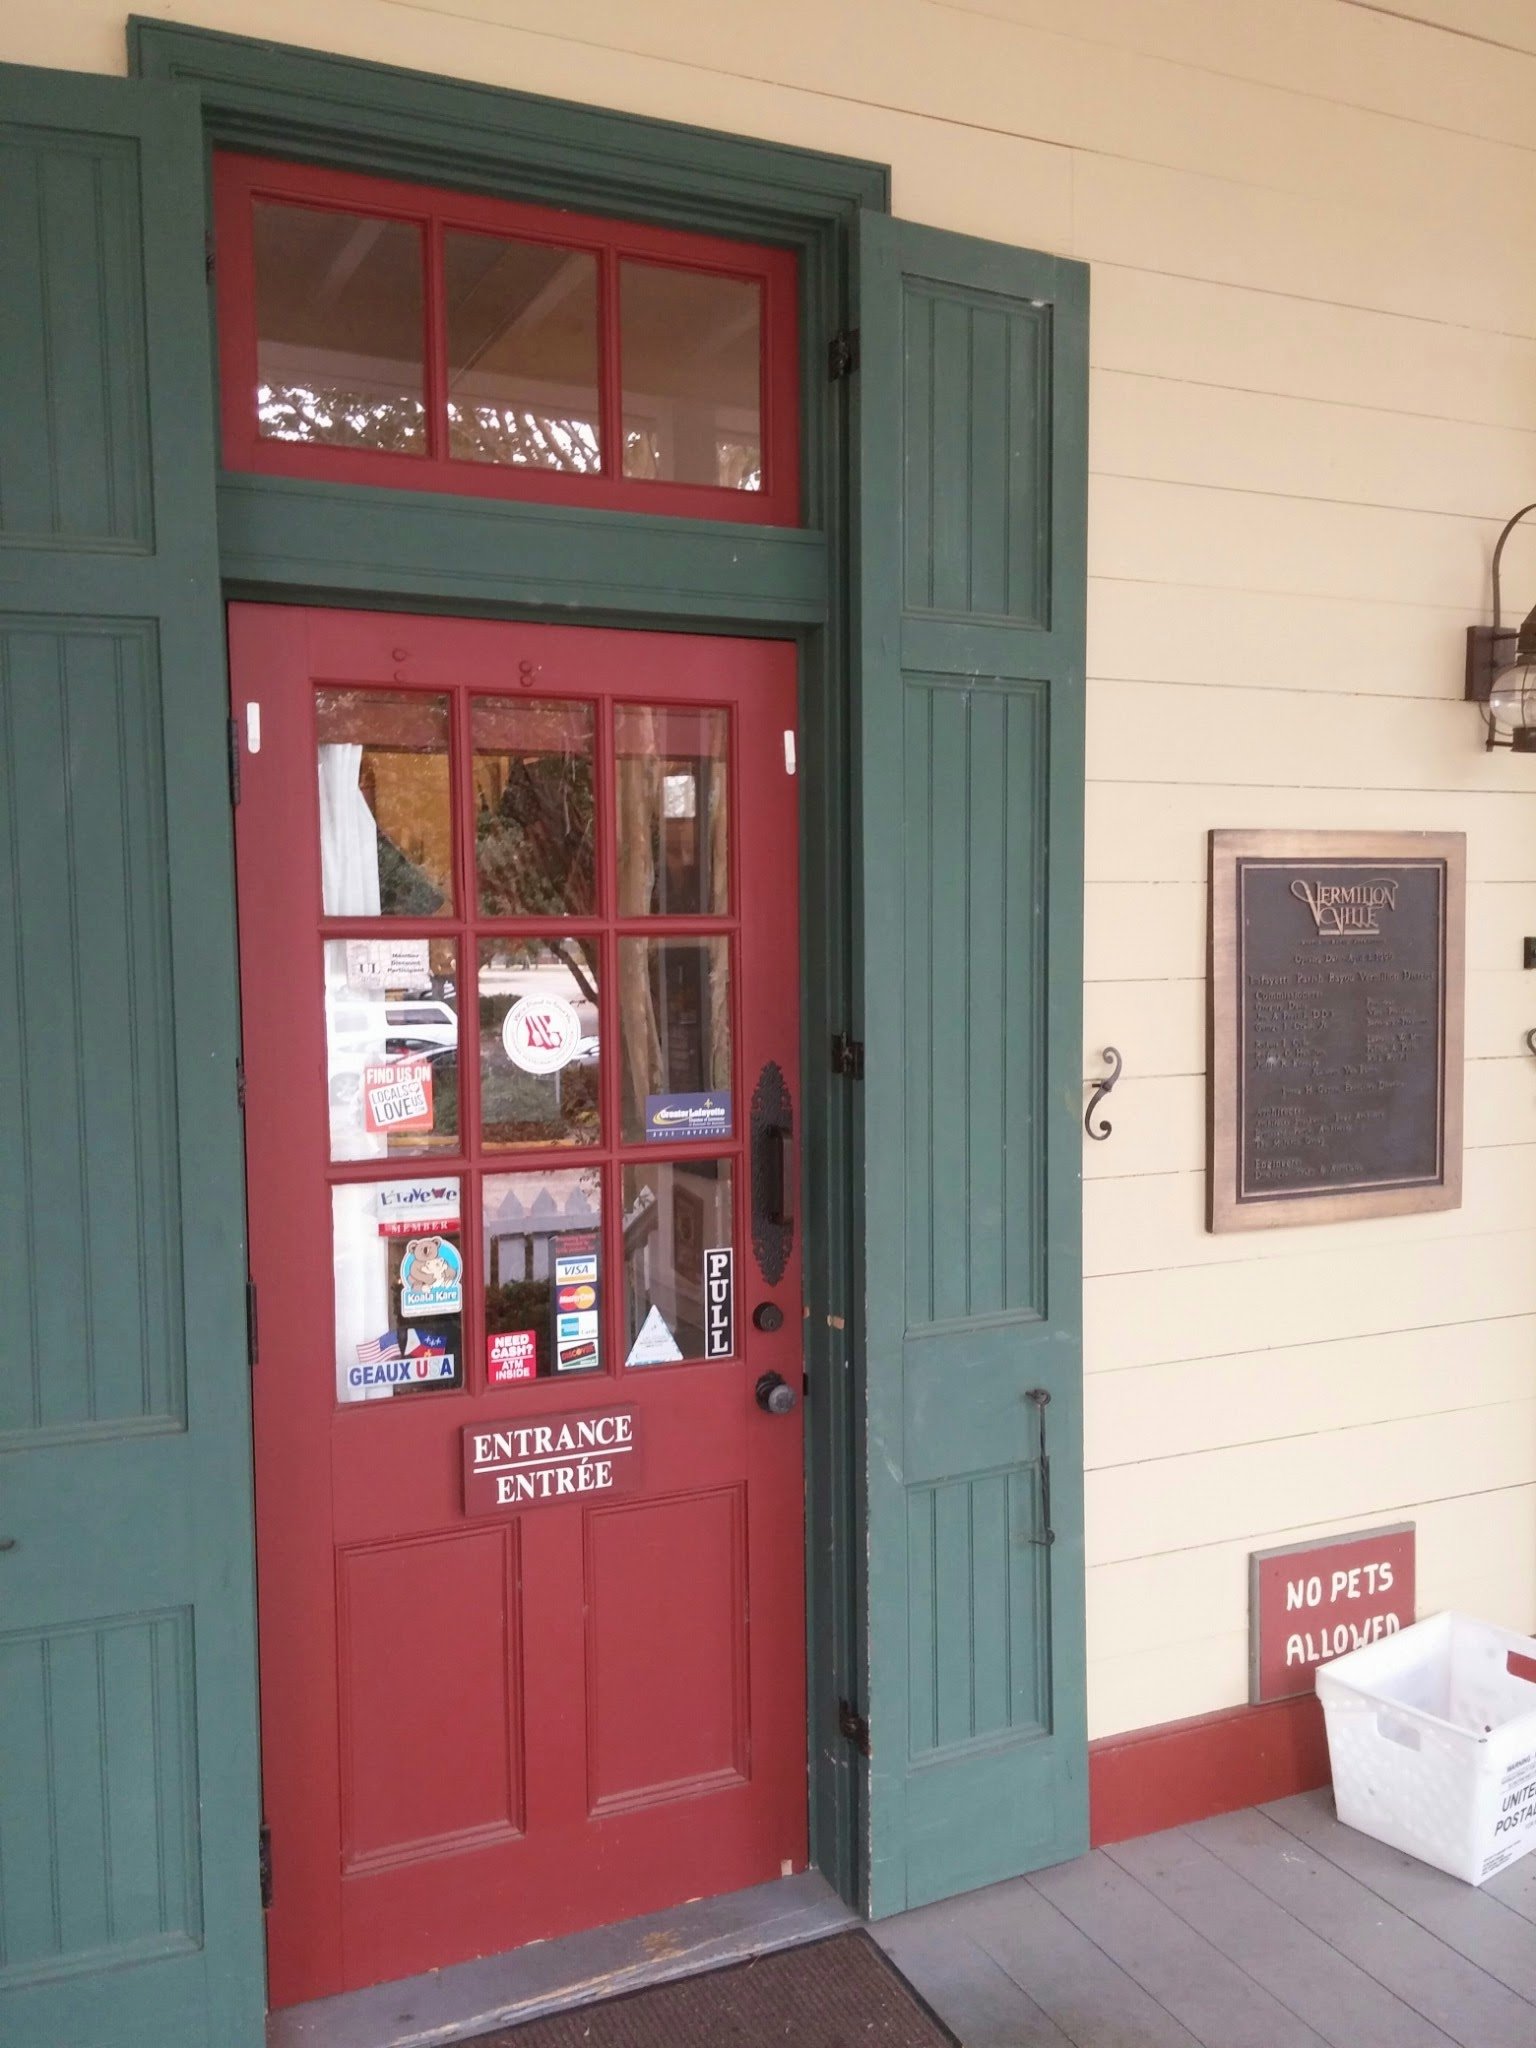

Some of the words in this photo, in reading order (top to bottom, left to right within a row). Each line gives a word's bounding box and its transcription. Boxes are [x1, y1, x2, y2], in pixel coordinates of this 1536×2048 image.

[1248, 974, 1294, 986] Lafayett
[366, 1067, 395, 1085] FIND
[397, 1066, 412, 1082] US
[414, 1065, 432, 1082] ON
[372, 1084, 409, 1105] LOCALS
[375, 1097, 413, 1123] LOVE
[411, 1095, 424, 1107] US
[660, 1108, 689, 1119] Greater
[689, 1107, 726, 1118] Lafayette
[391, 1220, 448, 1234] MEMBER
[564, 1264, 589, 1276] VISA
[407, 1292, 434, 1305] Koala
[435, 1290, 457, 1302] Kare
[709, 1254, 729, 1354] PULL
[494, 1333, 530, 1348] NEED
[491, 1345, 534, 1360] CASH?
[350, 1361, 412, 1386] GEAUX
[495, 1367, 531, 1381] INSIDE
[501, 1360, 524, 1371] ATM
[473, 1415, 633, 1463] ENTRANCE
[496, 1457, 613, 1504] ENTRÉE
[1286, 1576, 1322, 1611] NO
[1330, 1562, 1394, 1603] PETS
[1502, 1782, 1536, 1812] UNITE
